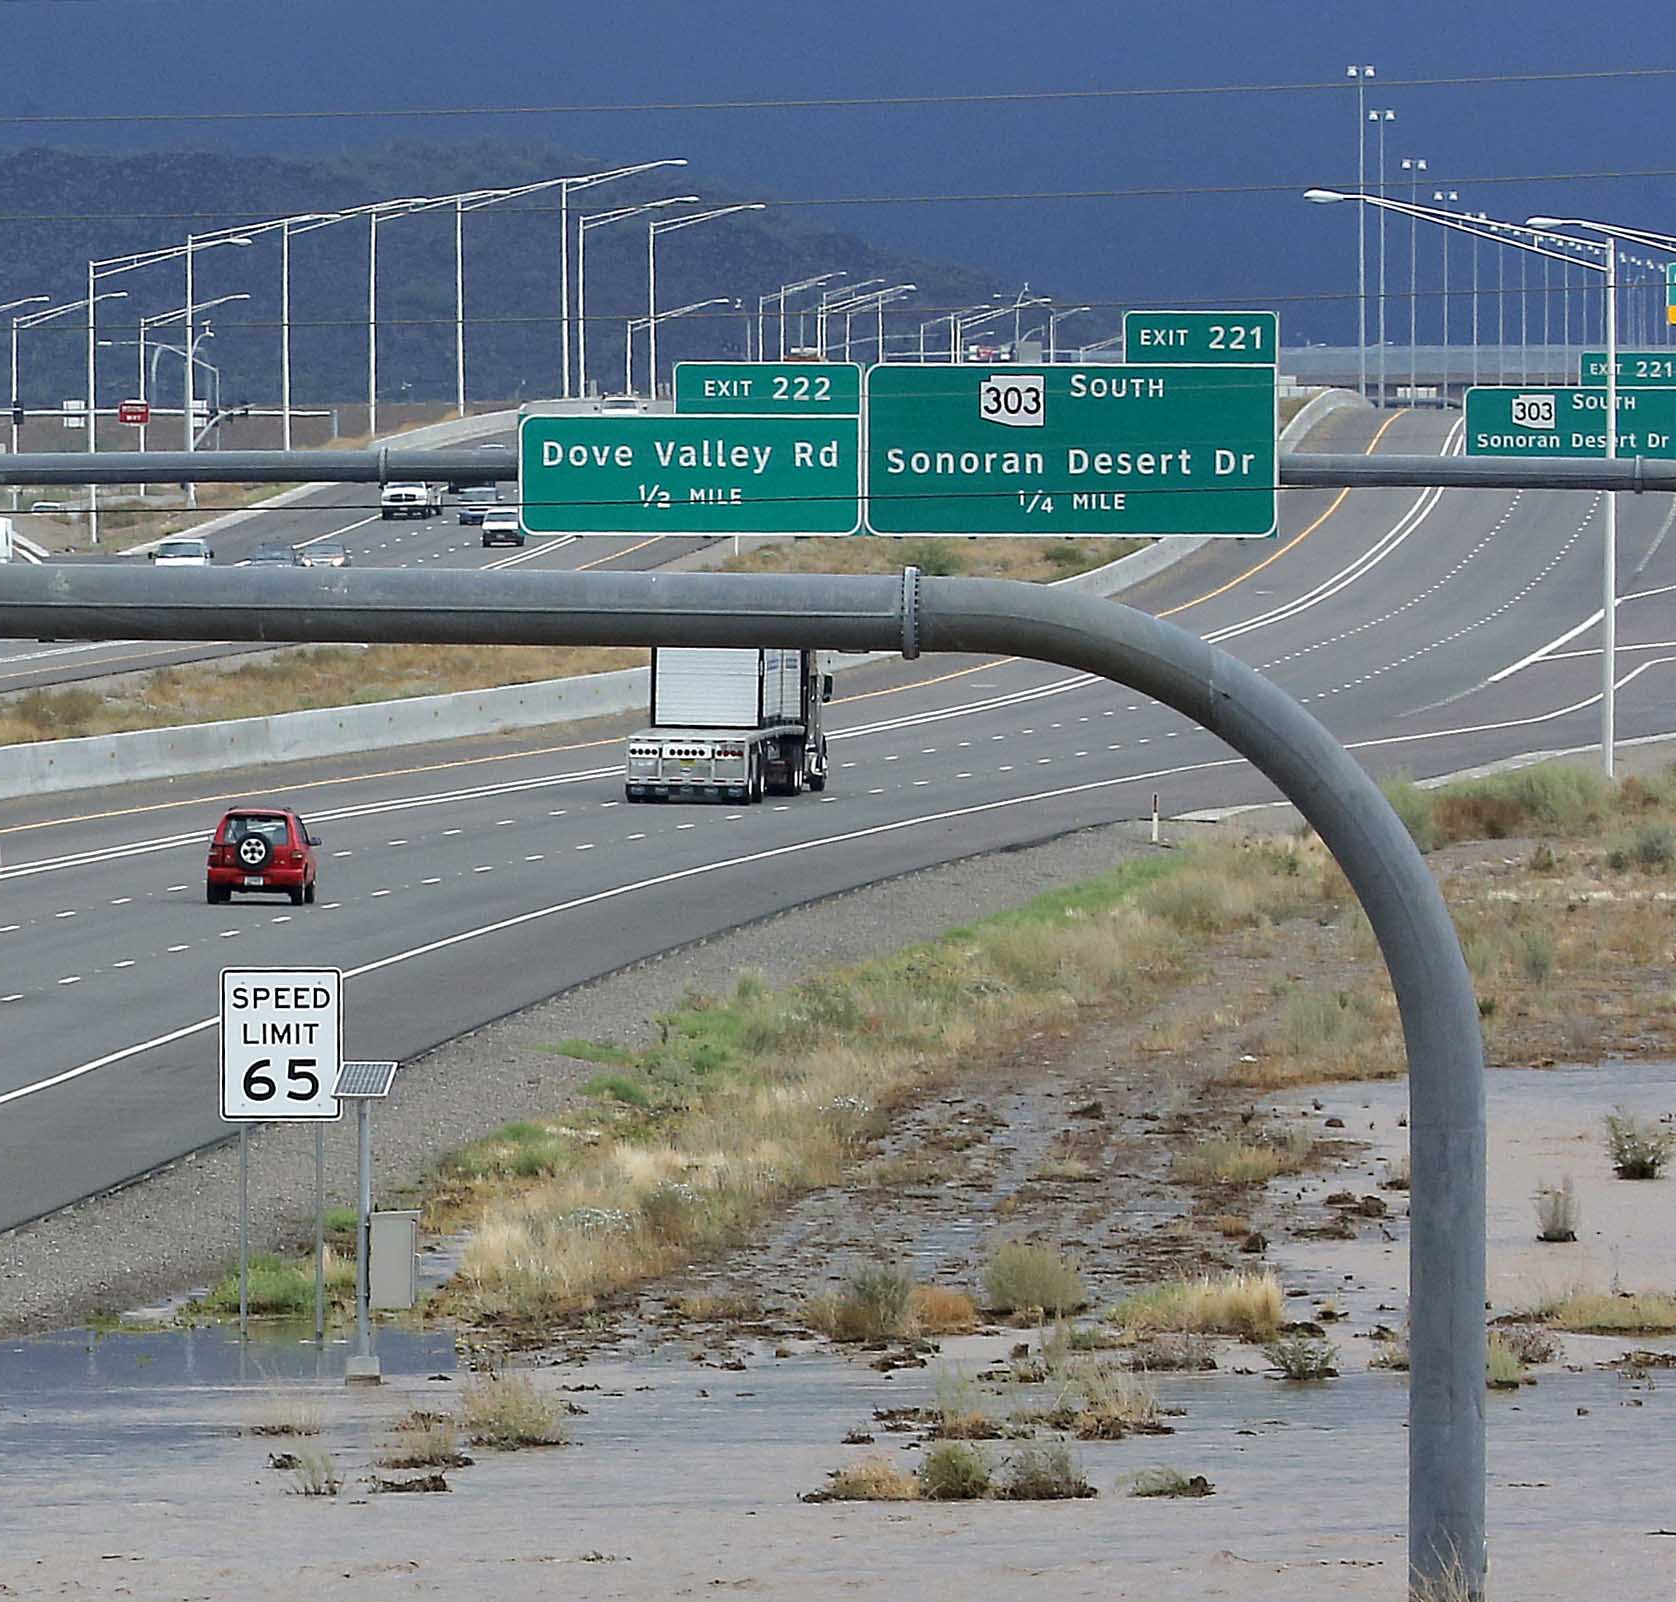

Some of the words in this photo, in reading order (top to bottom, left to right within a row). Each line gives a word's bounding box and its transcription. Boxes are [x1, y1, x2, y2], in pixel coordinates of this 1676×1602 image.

[1141, 330, 1189, 347] EXIT
[1209, 326, 1264, 350] 221
[1590, 363, 1623, 375] EXT
[1636, 361, 1673, 378] 221
[705, 379, 752, 397] EXIT
[772, 377, 832, 401] 222
[983, 387, 1042, 415] 303
[1070, 374, 1164, 398] SOUTH
[1514, 402, 1553, 421] 303
[1477, 433, 1560, 449] Sonoran
[1571, 433, 1637, 449] Desrt
[1648, 433, 1670, 449] Dr
[543, 442, 633, 467] Dove
[655, 440, 772, 474] Valley
[794, 441, 838, 467] Rd
[886, 449, 1044, 475] Sonoran
[1068, 449, 1191, 475] Desert
[1214, 450, 1256, 475] Dr
[689, 488, 742, 505] MILE
[1072, 493, 1126, 511] MILE
[232, 987, 330, 1009] SPEED
[243, 1023, 319, 1045] LIMIT
[243, 1059, 320, 1101] 65
